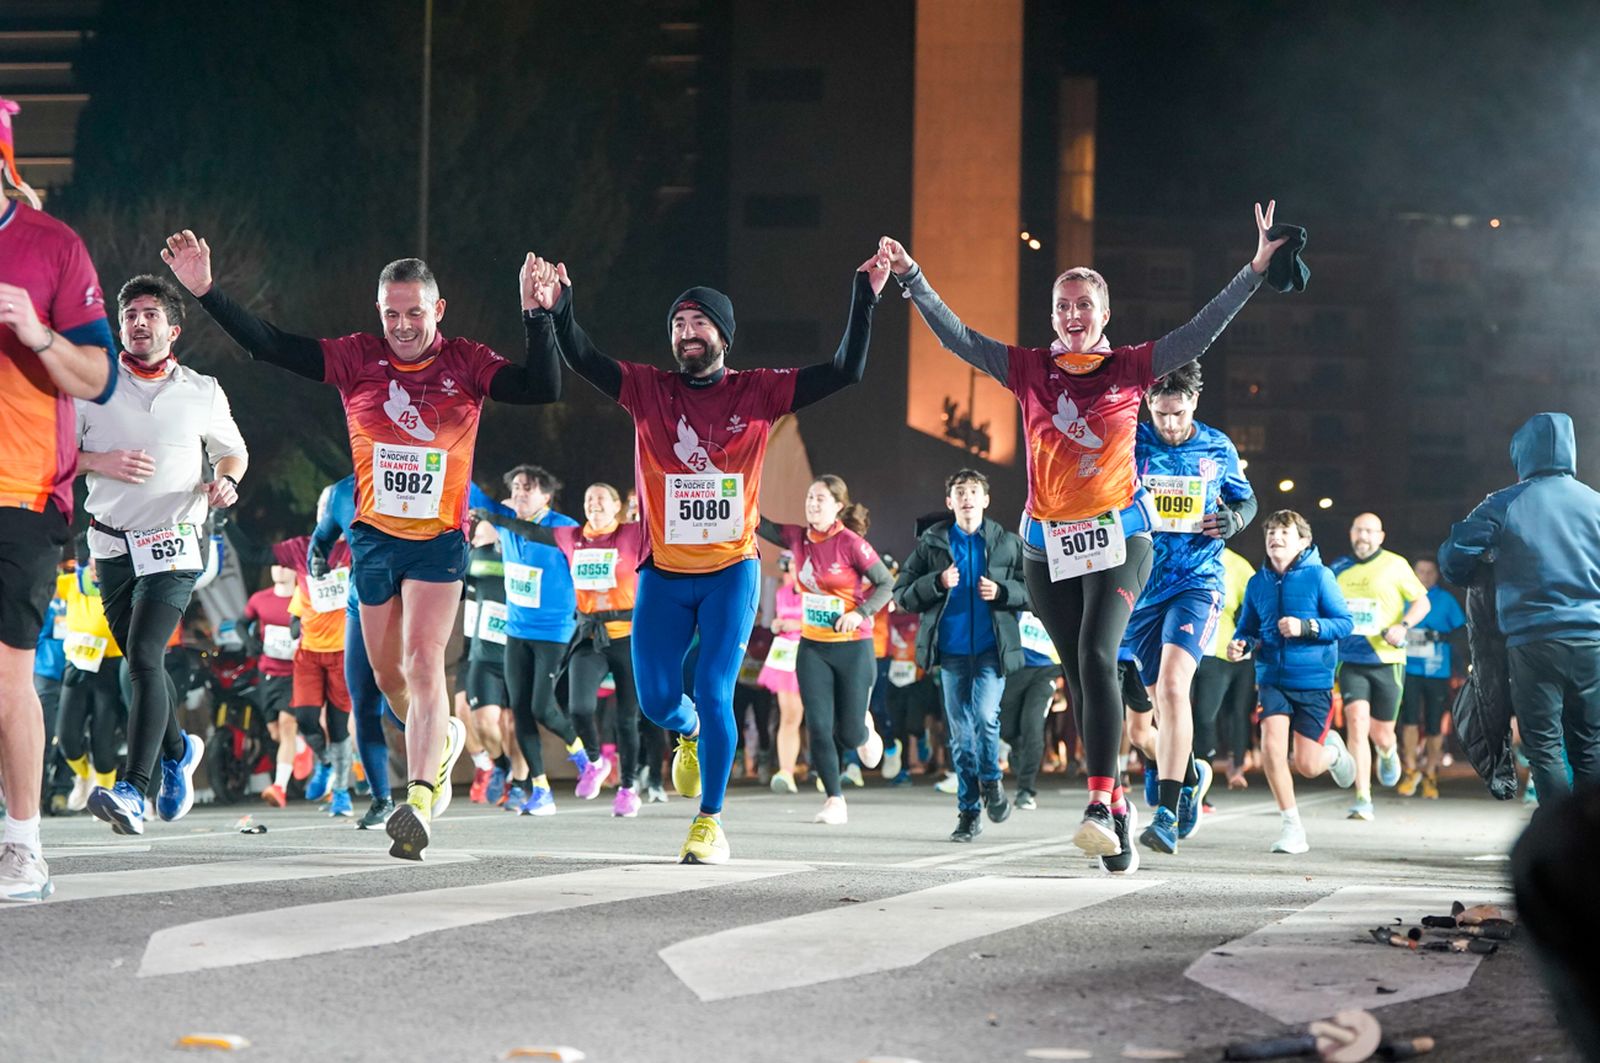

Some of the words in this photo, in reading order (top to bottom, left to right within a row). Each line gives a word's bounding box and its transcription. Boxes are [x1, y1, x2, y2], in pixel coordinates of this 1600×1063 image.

[398, 410, 418, 430] 43
[1068, 422, 1086, 439] 43
[380, 461, 391, 469] SAN
[387, 453, 409, 462] NOCHE
[687, 452, 707, 471] 43
[384, 470, 433, 494] 6982
[683, 481, 706, 489] NOCHE
[706, 481, 715, 489] DE
[674, 490, 689, 498] SAN
[679, 499, 730, 520] 5080
[1155, 496, 1193, 513] 1099
[1052, 528, 1067, 537] SAN
[136, 538, 151, 548] SAN
[151, 538, 187, 560] 632
[1060, 527, 1109, 556] 5079
